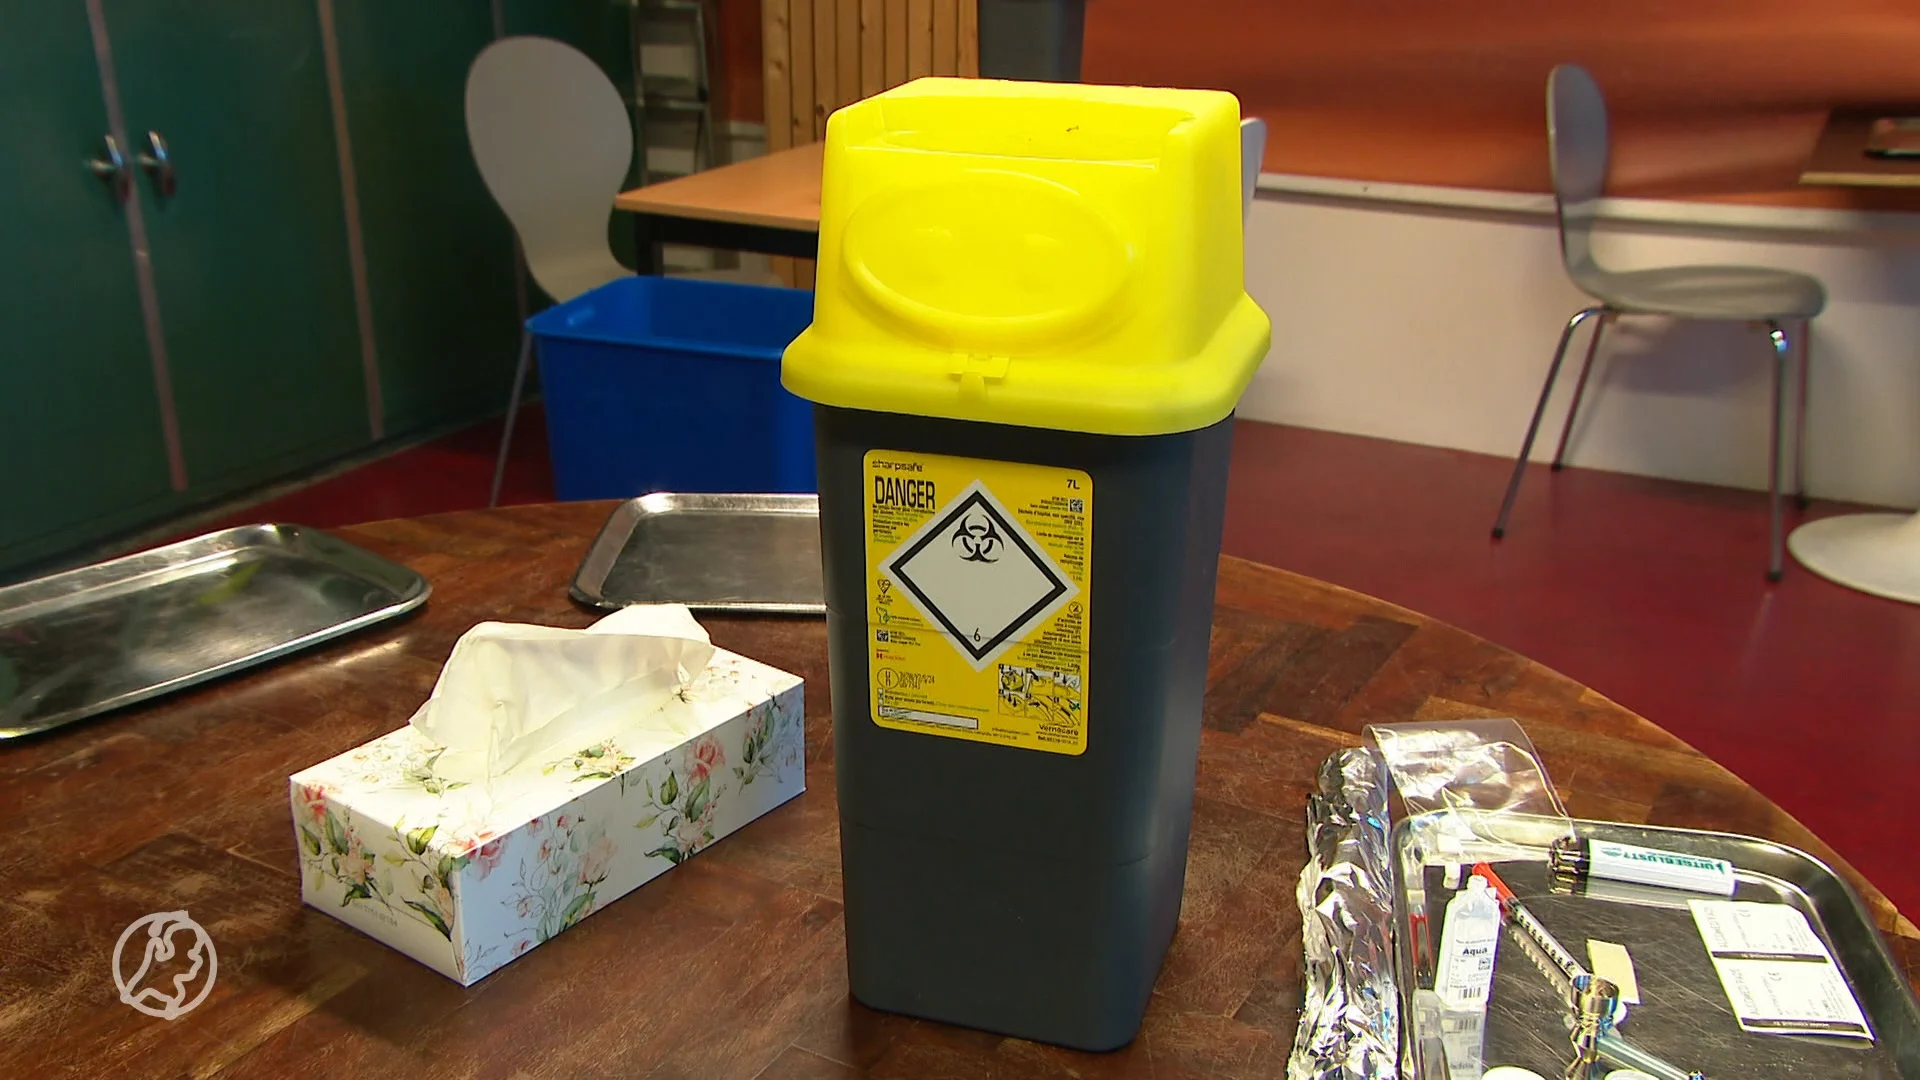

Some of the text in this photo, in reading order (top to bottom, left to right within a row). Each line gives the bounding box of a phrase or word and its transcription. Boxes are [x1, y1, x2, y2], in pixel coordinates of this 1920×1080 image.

[872, 459, 923, 473] sharpsafe
[1066, 478, 1081, 490] 7L
[874, 475, 936, 510] DANGER
[973, 627, 981, 643] 6
[1039, 723, 1079, 736] Vernacare
[1462, 946, 1488, 957] Aqua
